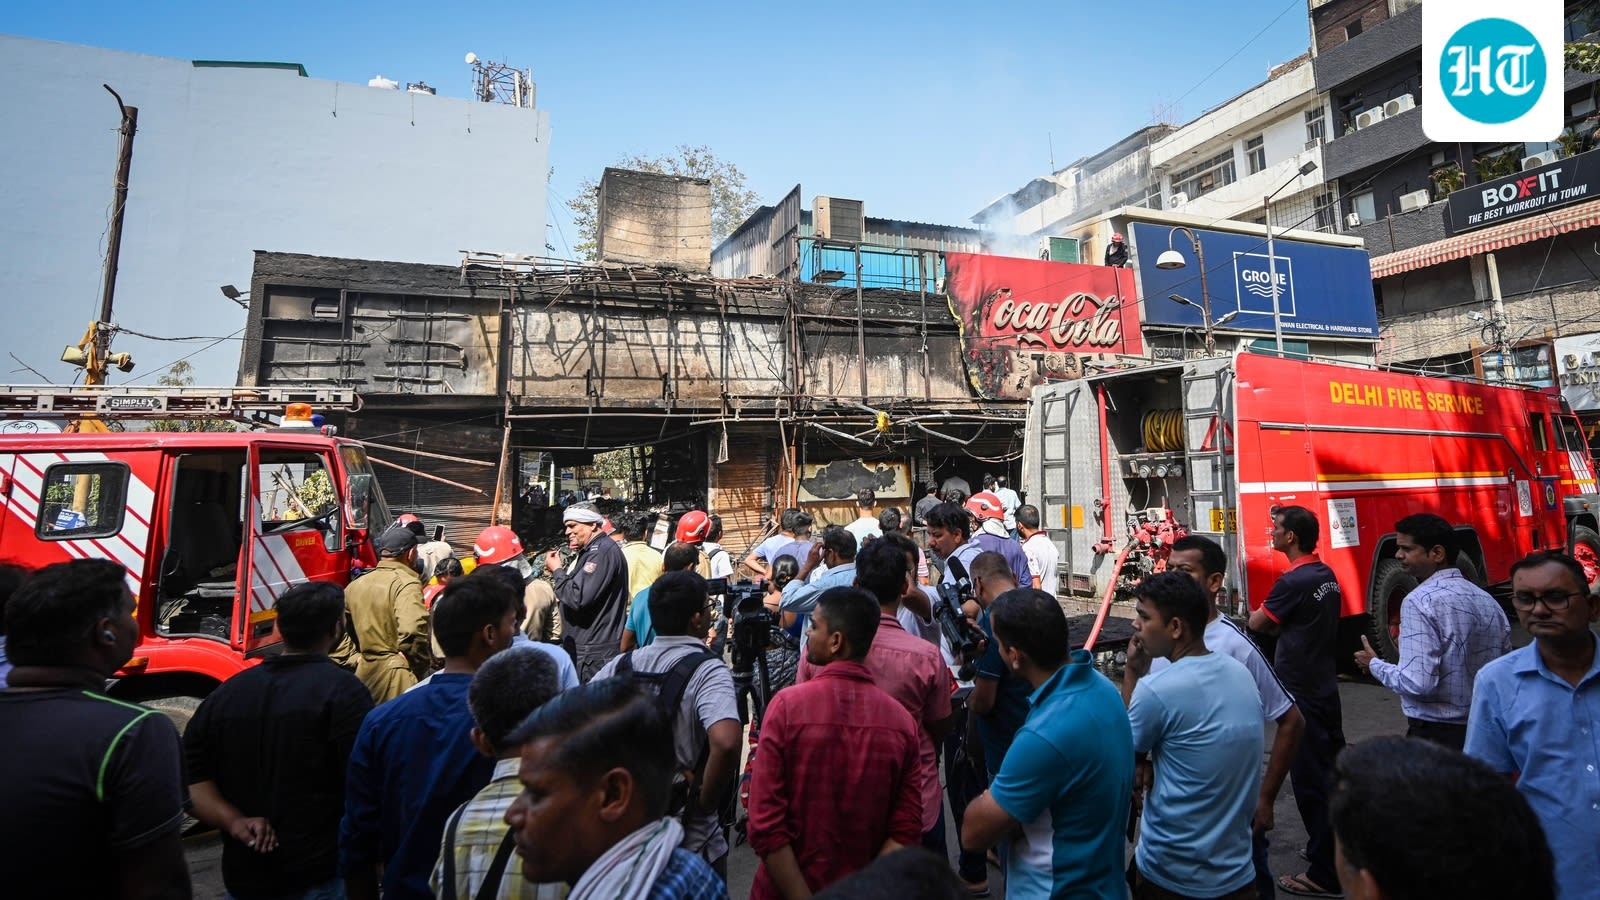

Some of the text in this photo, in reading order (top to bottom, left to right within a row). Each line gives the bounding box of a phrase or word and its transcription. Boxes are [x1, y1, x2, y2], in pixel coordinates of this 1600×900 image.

[1468, 184, 1587, 225] THE BEST WORKOUT IN TOWN
[1482, 168, 1562, 208] BOXFIT
[1280, 321, 1295, 330] AWAN
[1296, 323, 1324, 331] ELECTRICAL
[1330, 325, 1357, 333] HARDWARE
[111, 398, 154, 408] SIMPLEX
[1329, 380, 1484, 416] DELHI FIRE SERVICE
